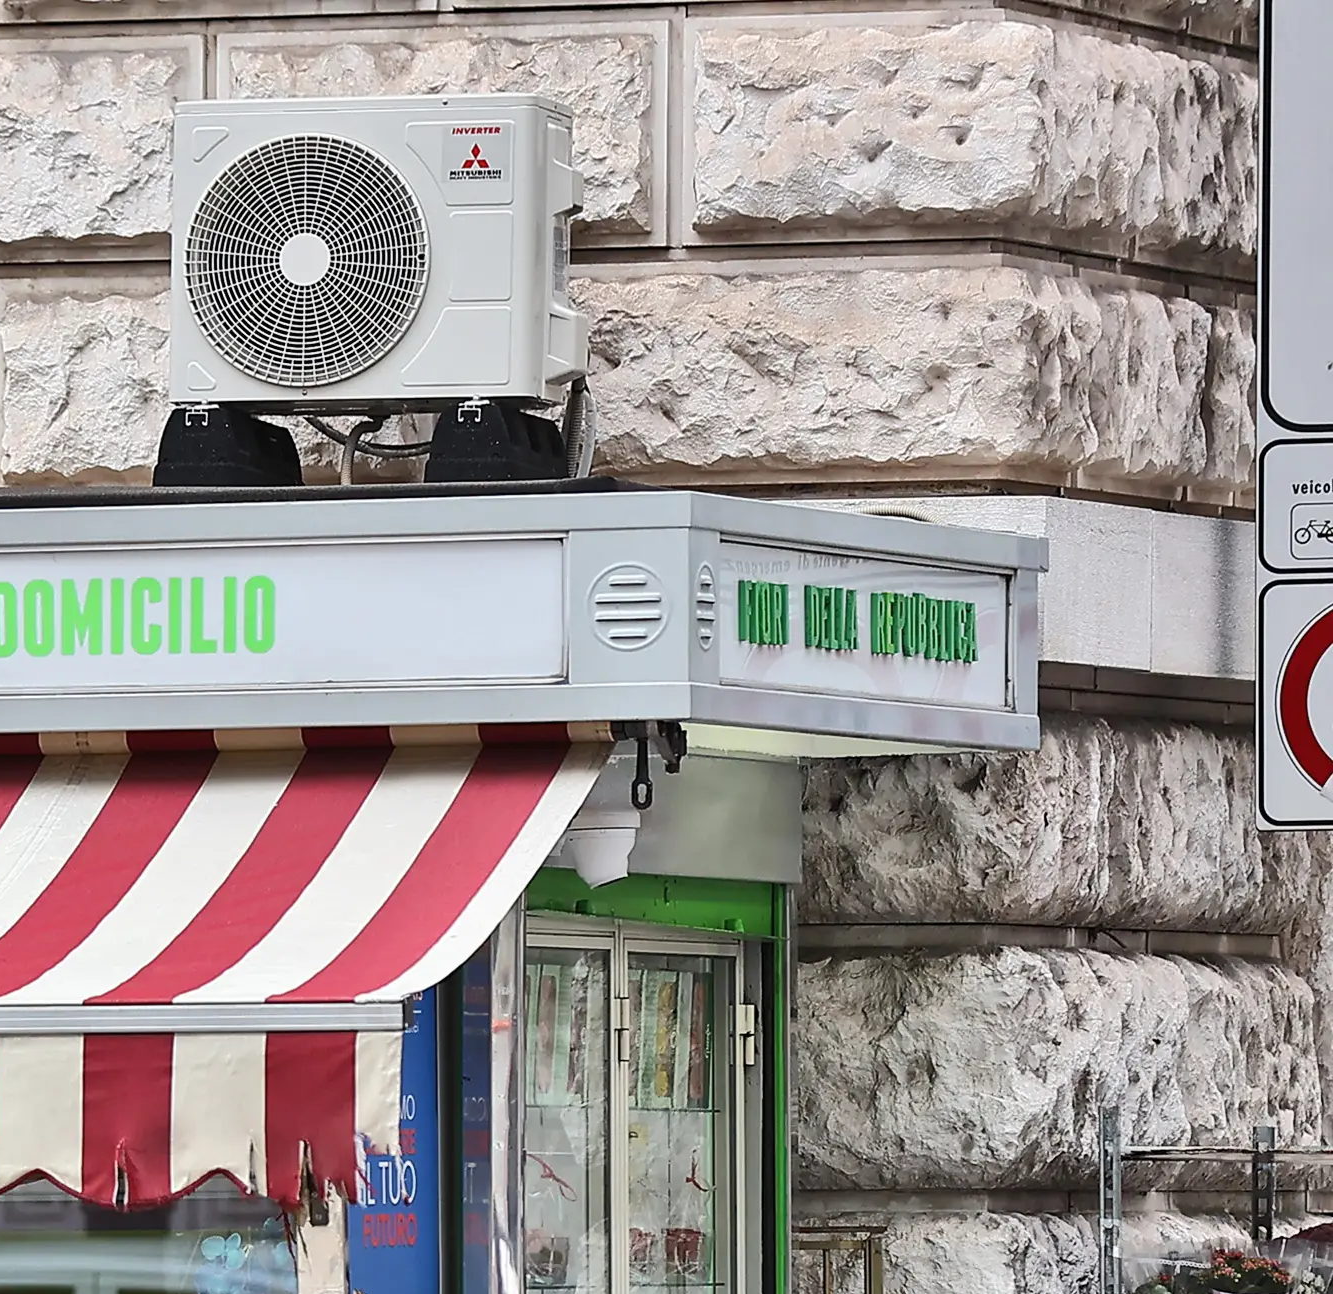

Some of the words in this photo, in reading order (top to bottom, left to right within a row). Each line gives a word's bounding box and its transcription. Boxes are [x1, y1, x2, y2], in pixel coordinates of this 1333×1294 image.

[452, 127, 501, 135] INVERTER
[804, 584, 860, 651] DELLA
[870, 592, 980, 665] REPUBBLICA
[378, 1160, 417, 1205] TUO
[363, 1213, 418, 1247] FUTURO
